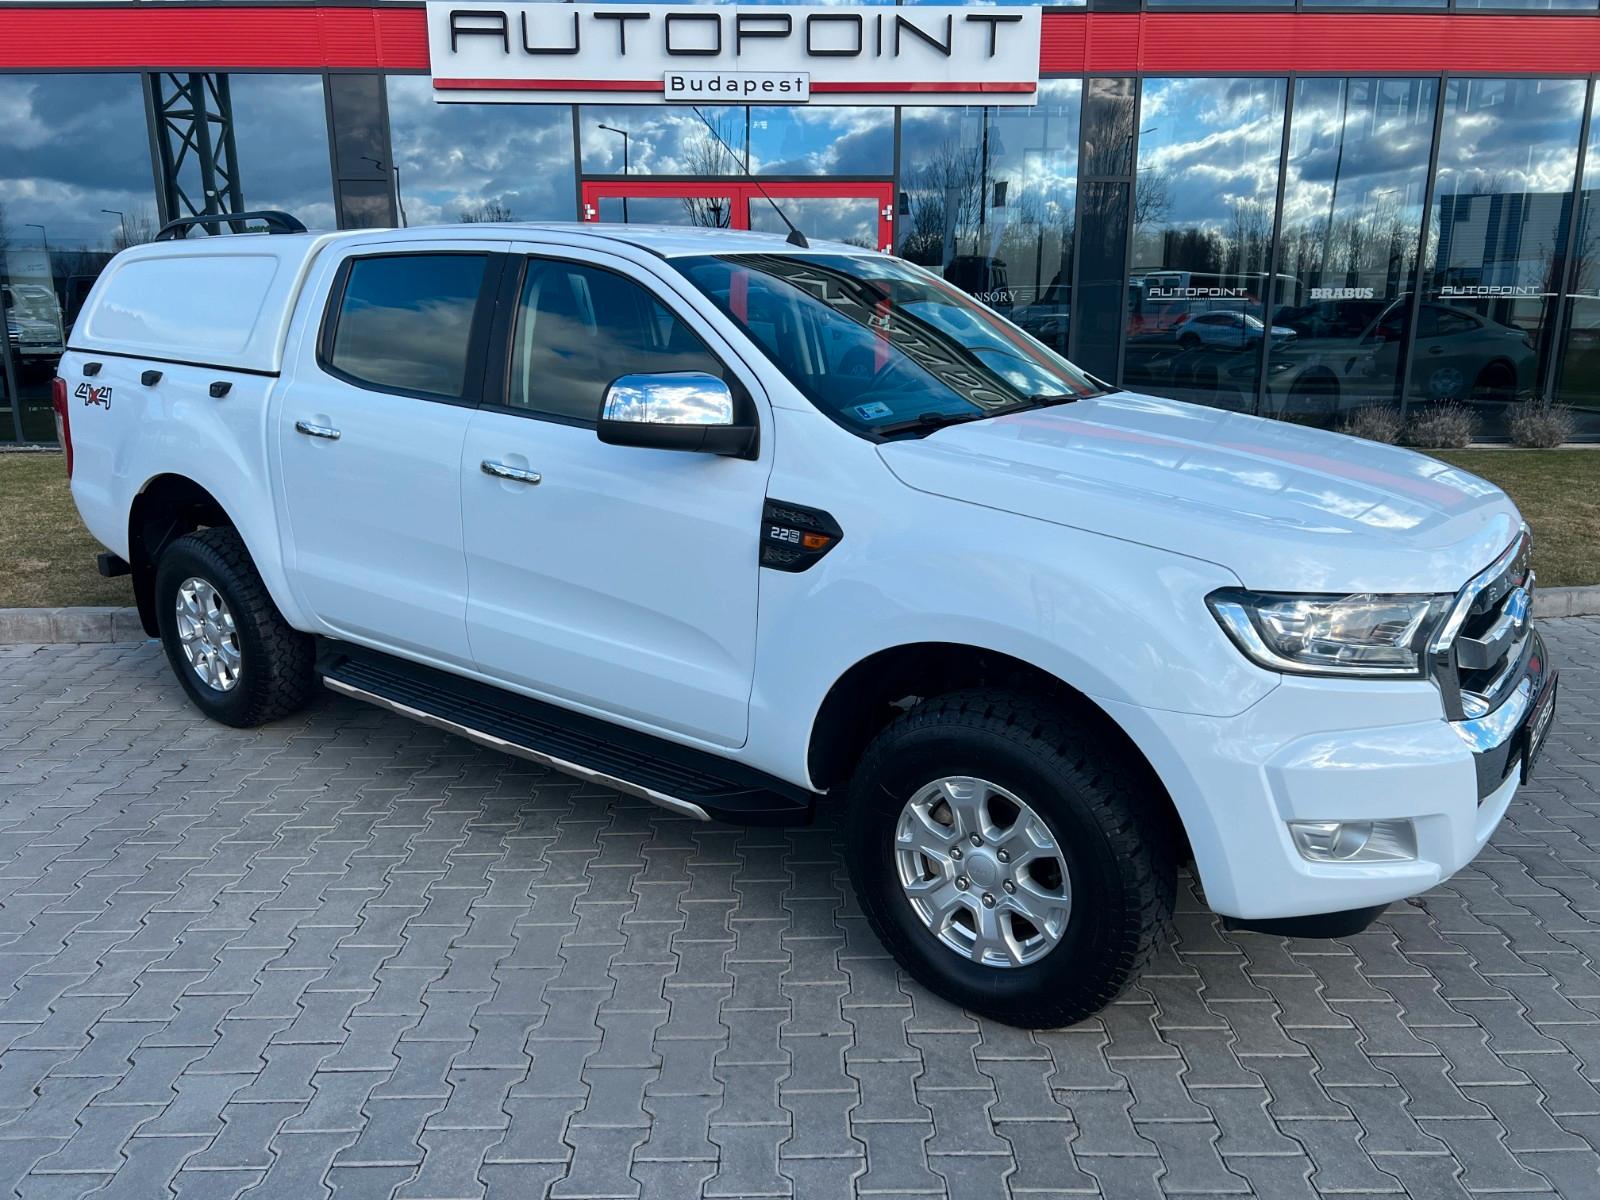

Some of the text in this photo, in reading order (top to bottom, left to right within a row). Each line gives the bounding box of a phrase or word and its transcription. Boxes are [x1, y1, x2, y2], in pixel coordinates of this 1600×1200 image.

[449, 10, 1023, 58] AUTOPOINT
[671, 75, 804, 96] Budapest
[1149, 287, 1248, 297] AUTOPOINT
[1310, 287, 1374, 299] BRABUS
[1441, 285, 1540, 295] AUTOPOINT
